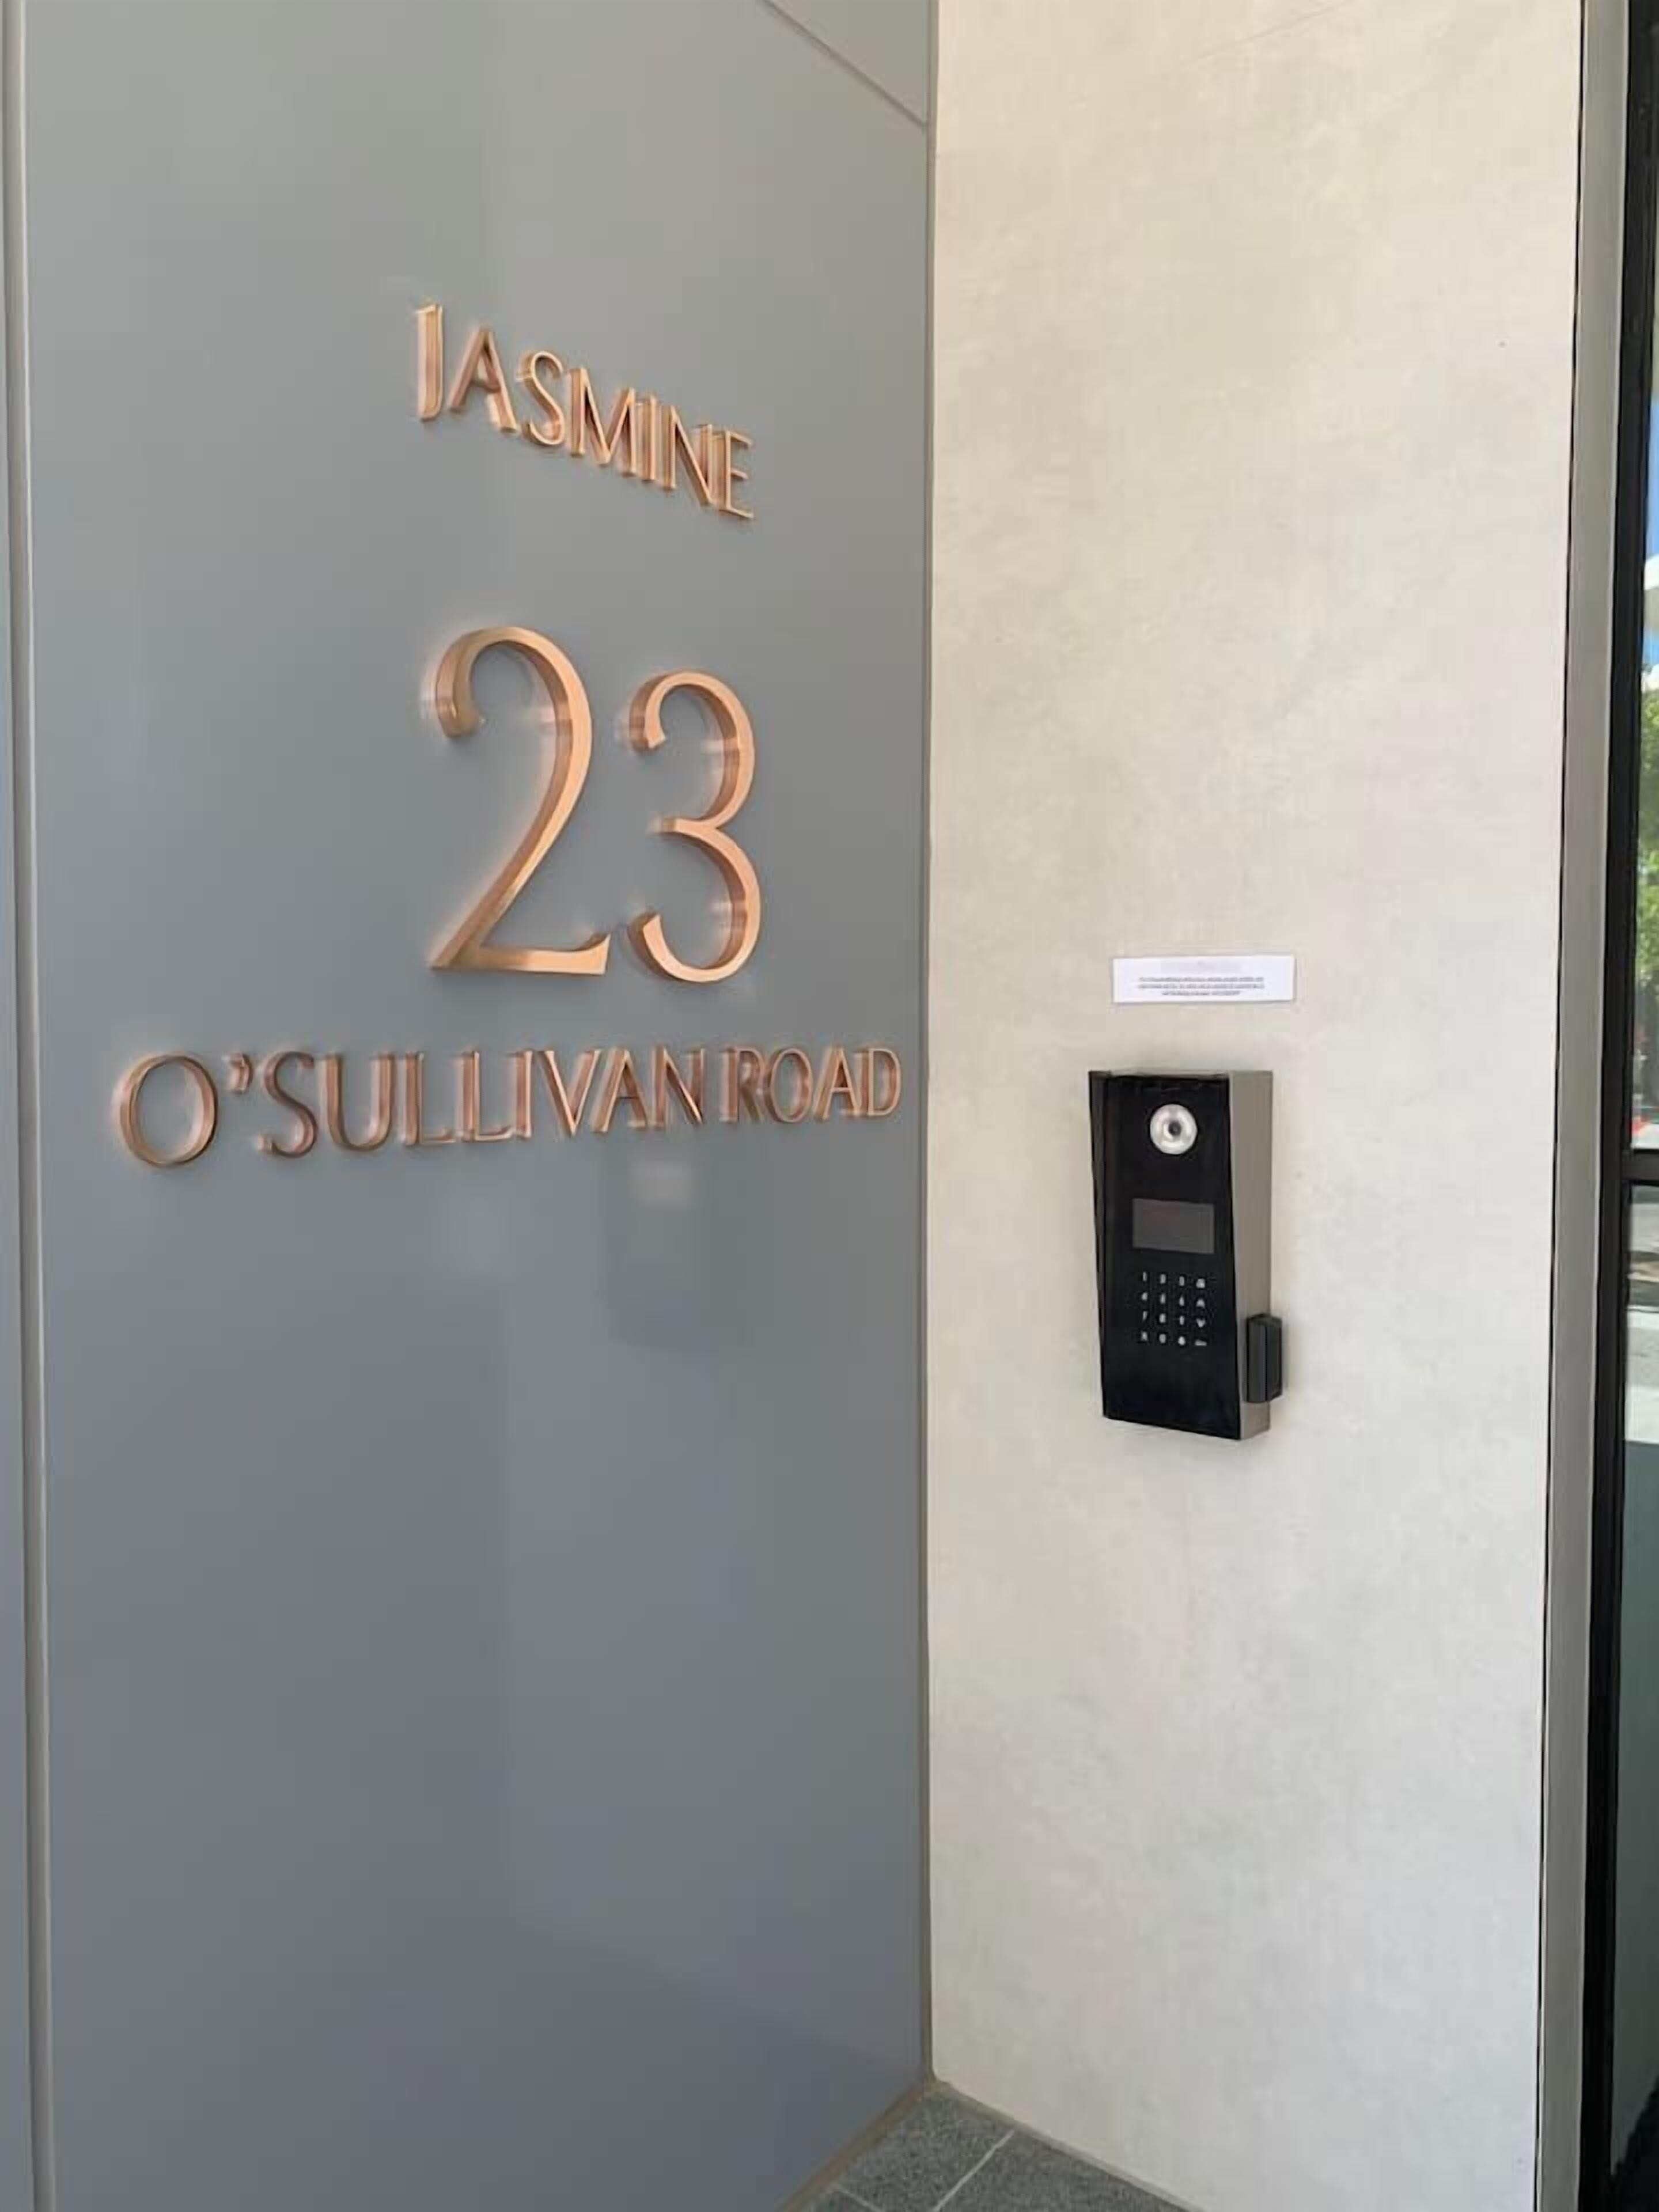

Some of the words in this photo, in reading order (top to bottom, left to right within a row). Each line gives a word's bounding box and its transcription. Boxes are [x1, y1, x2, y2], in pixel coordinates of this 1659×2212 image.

[412, 302, 755, 520] JASMINE
[429, 626, 763, 983] 23
[114, 1047, 706, 1167] O'SULLIVAN
[719, 1044, 902, 1124] ROAD
